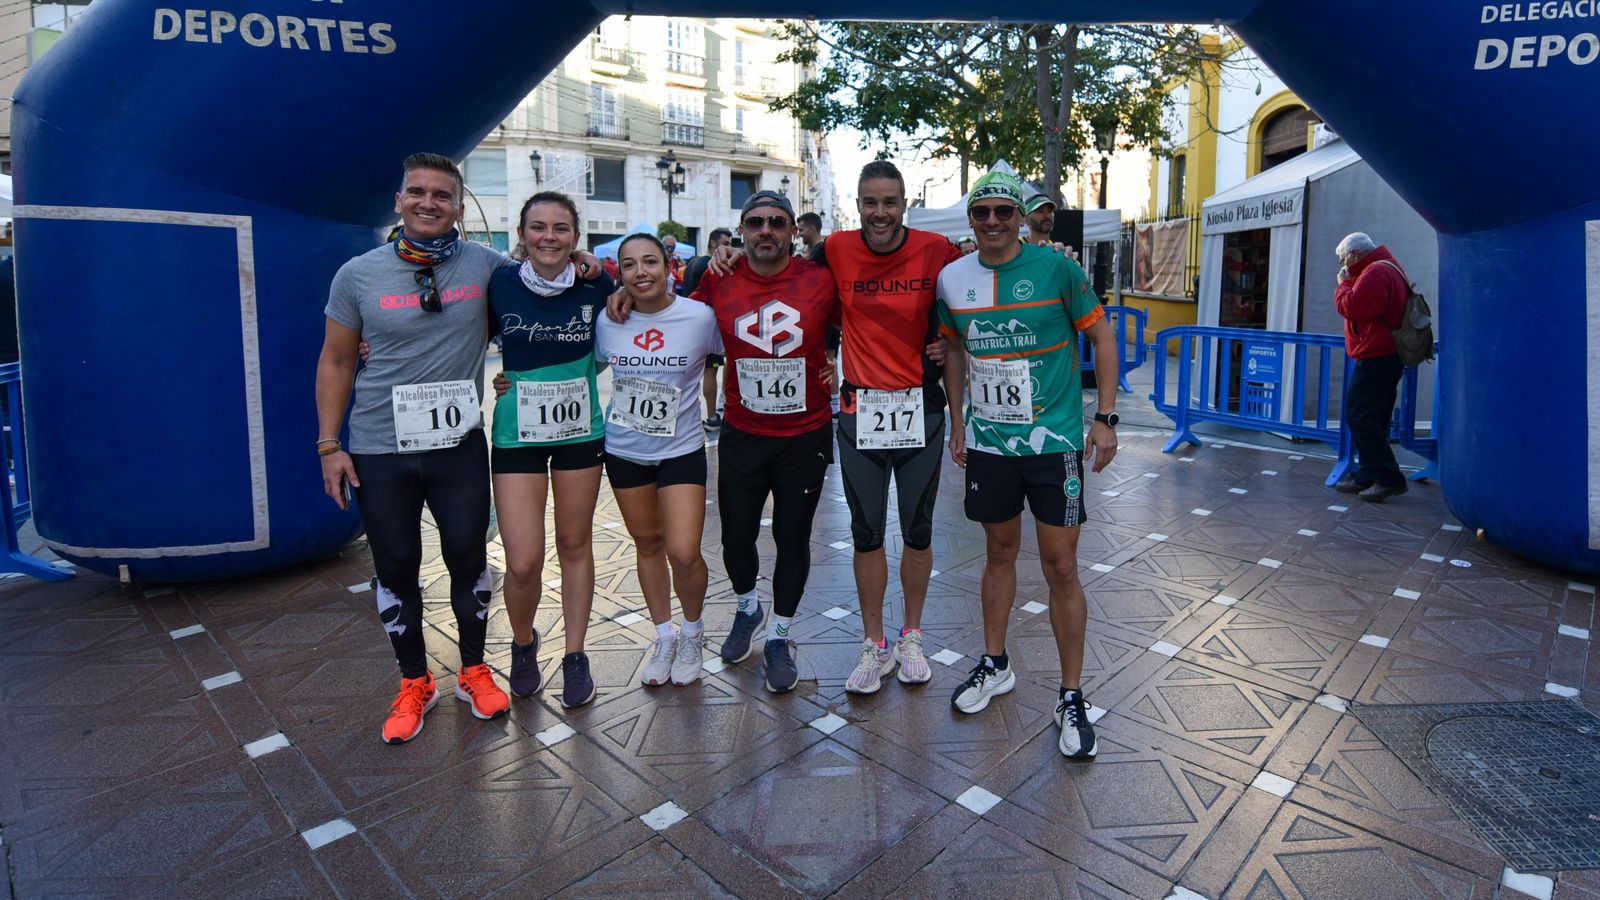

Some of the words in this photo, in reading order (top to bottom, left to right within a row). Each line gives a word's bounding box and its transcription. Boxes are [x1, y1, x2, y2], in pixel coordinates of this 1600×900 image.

[1481, 0, 1600, 24] DELEGACI
[153, 8, 397, 55] DEPORTES
[1474, 32, 1600, 70] DEPO
[1206, 209, 1234, 227] Kiosko
[1236, 204, 1259, 221] Plaza
[1262, 196, 1294, 220] Iglesia
[842, 277, 932, 293] DBOUNCE
[501, 313, 592, 342] Deportes
[966, 337, 1011, 351] EURAFRICA
[1012, 335, 1038, 347] TRAIL
[1248, 349, 1277, 357] DEPORTES
[611, 355, 688, 367] DBOUNCE
[755, 378, 797, 398] 146
[982, 383, 1021, 406] 118
[428, 405, 462, 430] 10
[537, 400, 581, 425] 100
[627, 396, 668, 420] 103
[872, 410, 915, 432] 217
